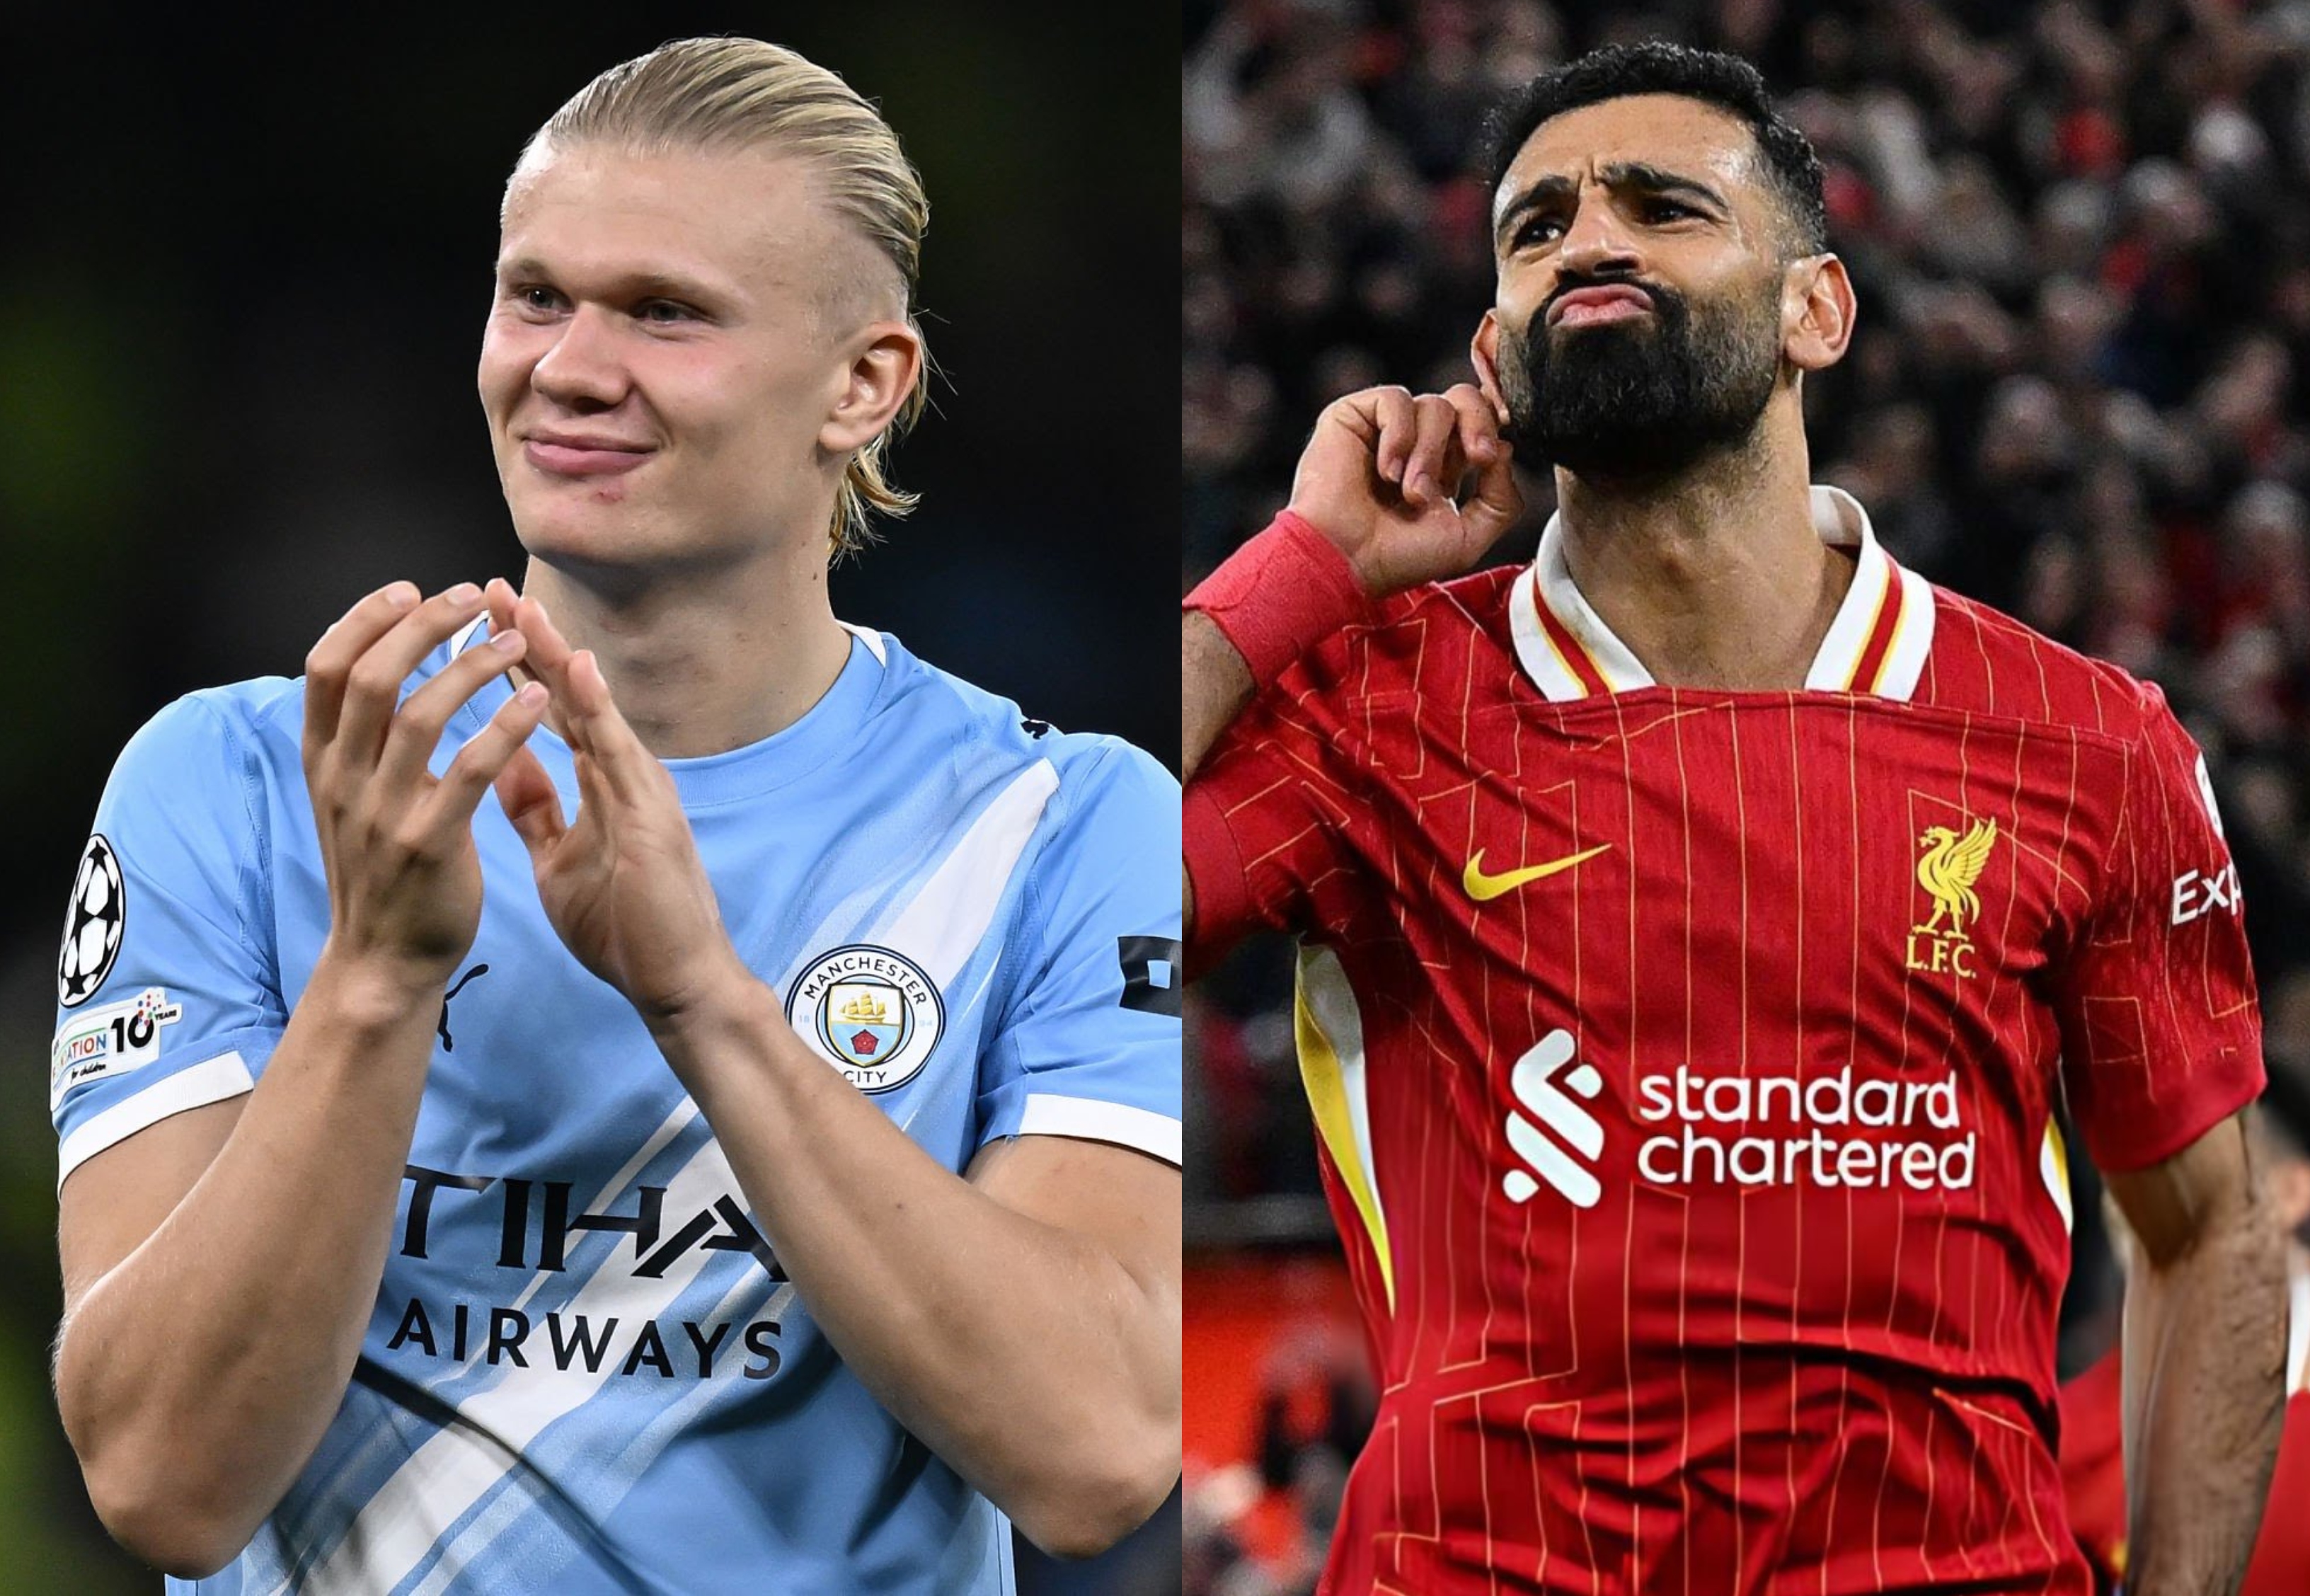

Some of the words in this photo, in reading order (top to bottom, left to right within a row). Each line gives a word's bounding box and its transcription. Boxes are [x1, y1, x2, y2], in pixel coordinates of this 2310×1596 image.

[2172, 862, 2241, 925] Exp
[804, 957, 927, 1005] MANCHESTER
[110, 1012, 154, 1053] 10
[844, 1071, 887, 1084] CITY
[1639, 1064, 1960, 1129] standard
[1638, 1124, 1976, 1190] chartered
[400, 1164, 791, 1282] TIHA
[386, 1297, 782, 1379] AIRWAYS
